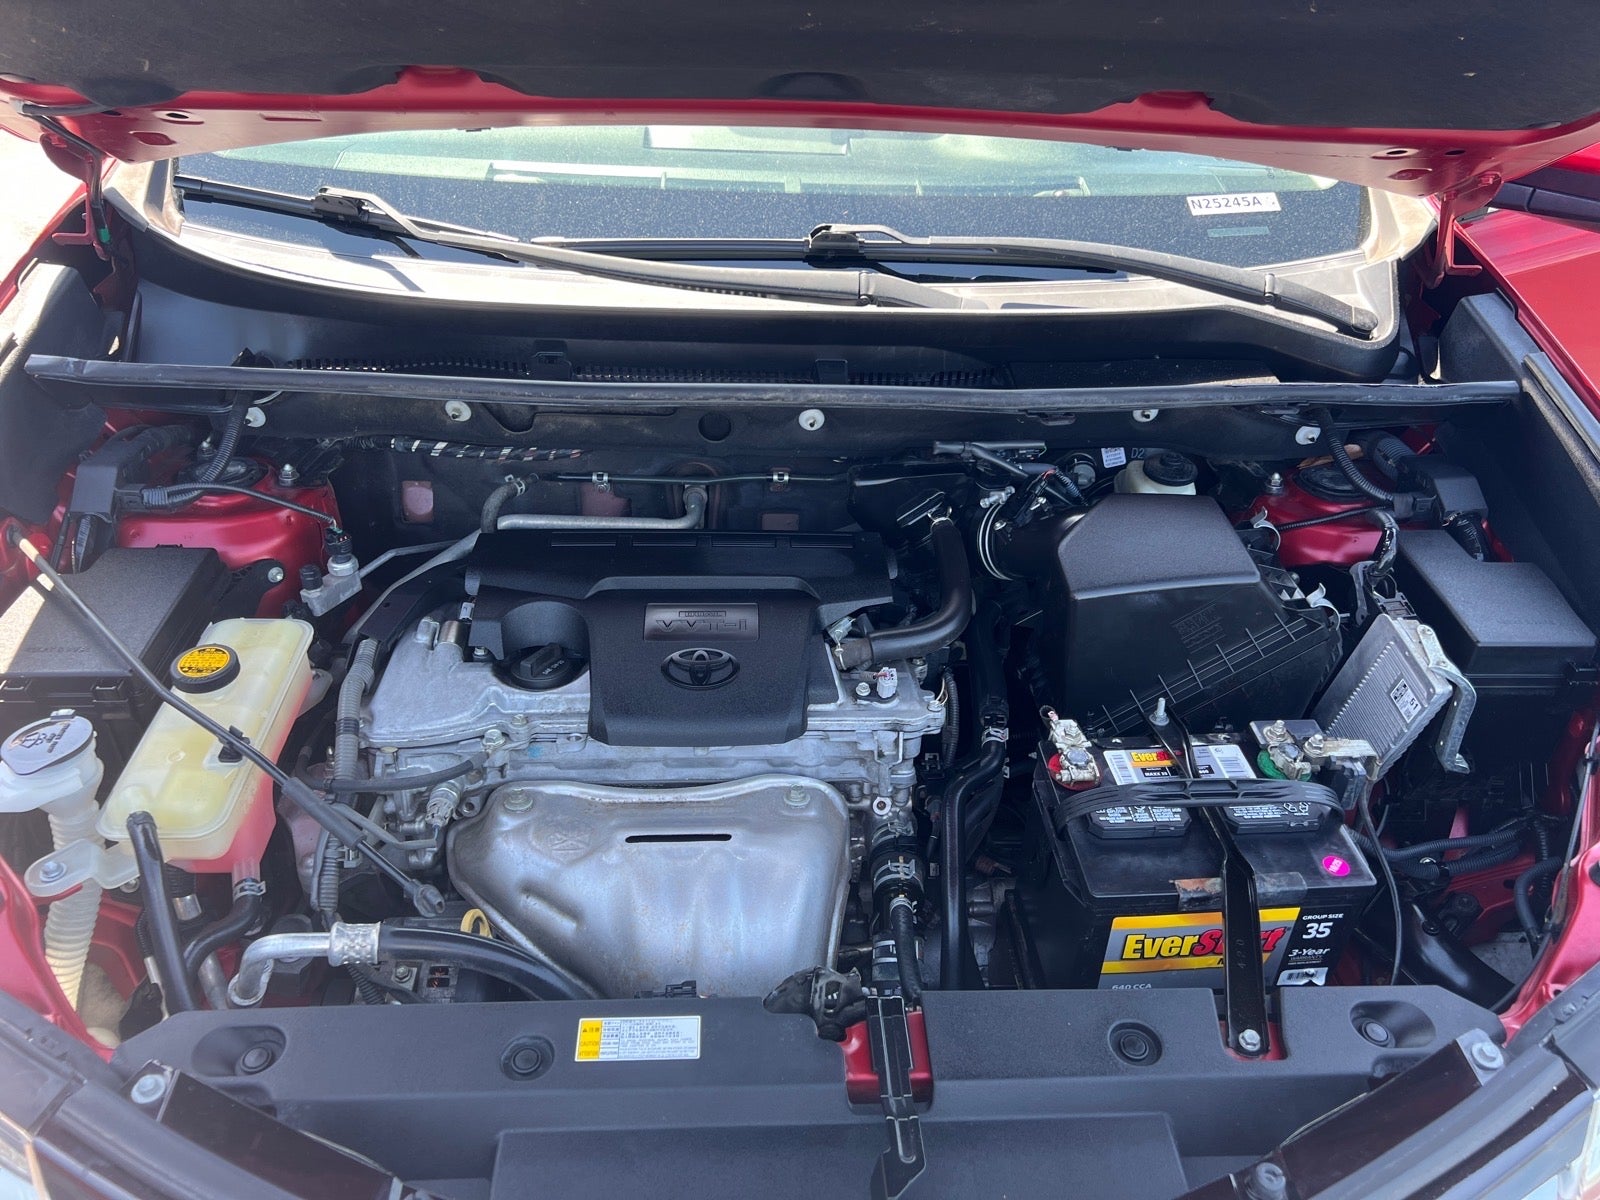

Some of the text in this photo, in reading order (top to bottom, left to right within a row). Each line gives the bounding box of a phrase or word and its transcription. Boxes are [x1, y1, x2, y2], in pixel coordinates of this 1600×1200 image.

[1190, 196, 1262, 210] N25245A
[1302, 922, 1333, 939] 35
[1288, 948, 1331, 957] 3-Year
